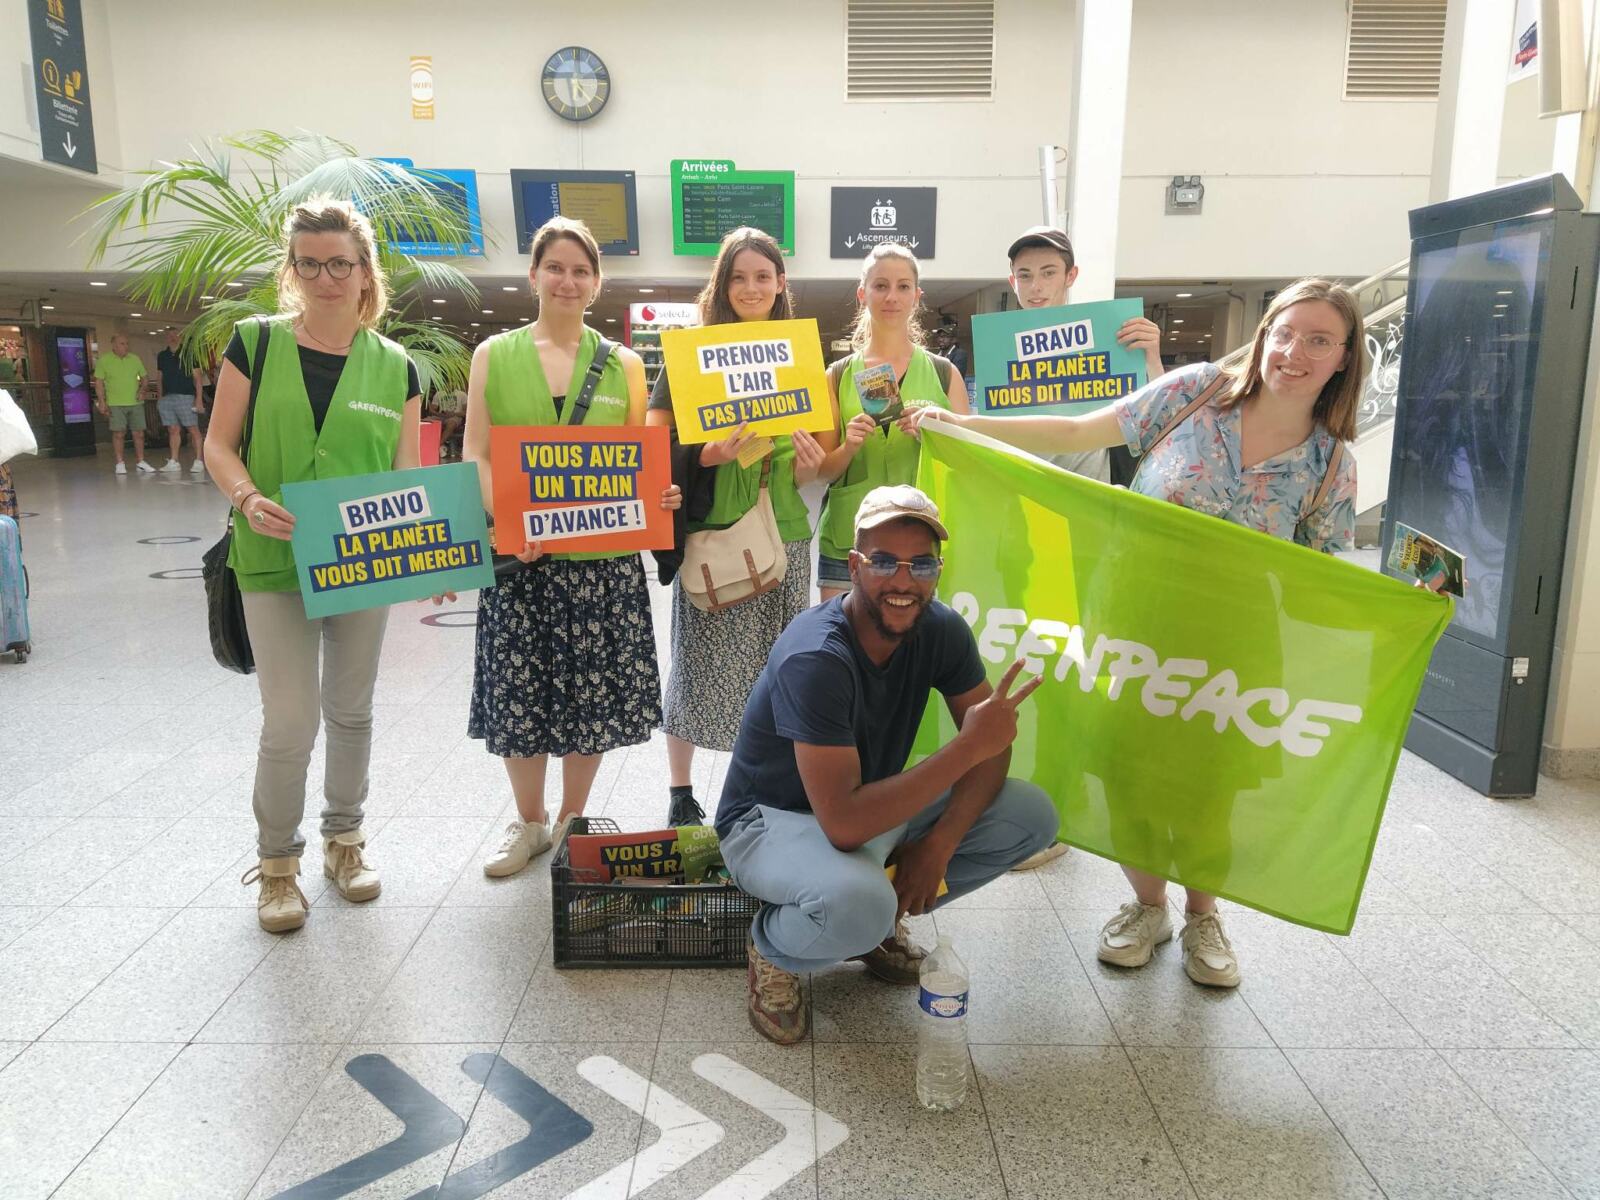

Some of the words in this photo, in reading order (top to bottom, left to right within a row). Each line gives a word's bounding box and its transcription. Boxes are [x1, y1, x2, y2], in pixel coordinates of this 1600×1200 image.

[681, 160, 729, 172] Arrivées
[550, 183, 560, 218] mation
[856, 232, 908, 243] Ascenseurs
[1020, 324, 1088, 356] BRAVO
[702, 342, 789, 369] PRENONS
[1011, 363, 1031, 382] LA
[1035, 352, 1107, 380] PLANÈTE
[727, 370, 774, 394] L’AIR
[988, 386, 1032, 407] VOUS
[1037, 383, 1064, 403] DIT
[1068, 378, 1121, 400] MERCI
[702, 404, 737, 427] PAS
[739, 393, 798, 420] L’AVION
[525, 445, 584, 468] VOUS
[589, 444, 639, 468] AVEZ
[534, 475, 564, 499] UN
[570, 474, 633, 498] TRAIN
[346, 491, 424, 528] BRAVO
[529, 505, 628, 536] D’AVANCE
[339, 536, 366, 558] LA
[368, 519, 448, 553] PLANÈTE
[314, 562, 368, 588] VOUS
[372, 556, 402, 579] DIT
[409, 546, 467, 573] MERCI
[605, 843, 663, 862] VOUS
[615, 863, 644, 877] UN
